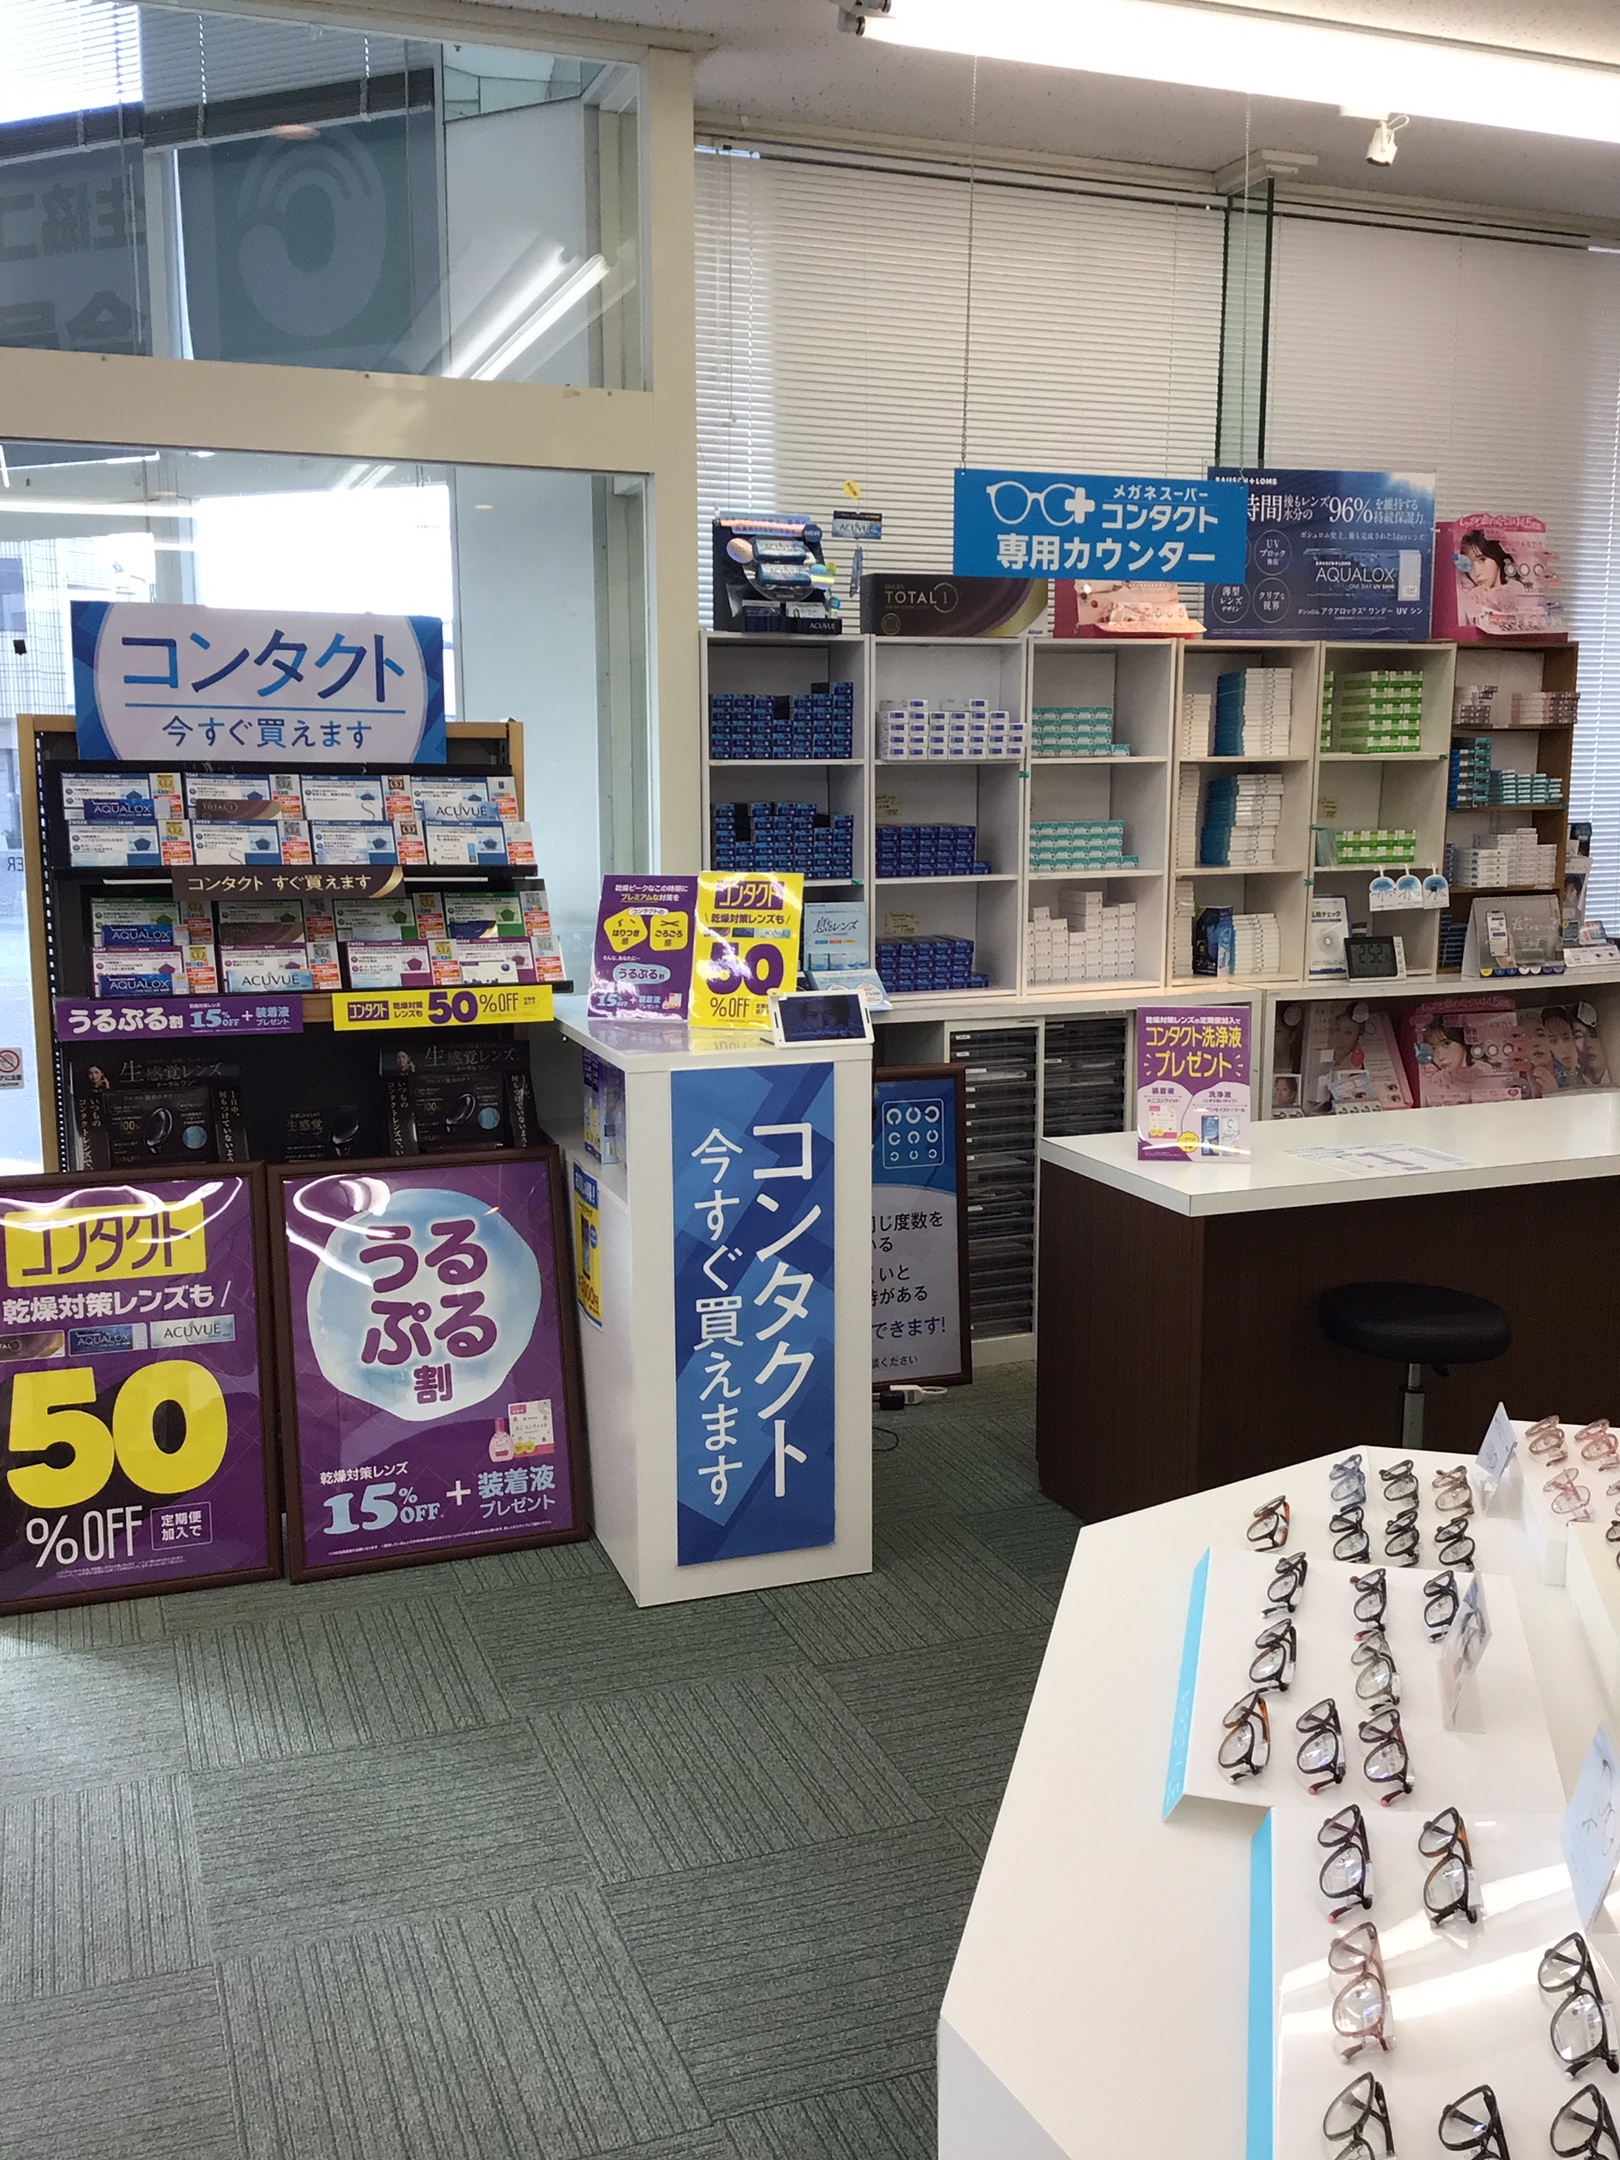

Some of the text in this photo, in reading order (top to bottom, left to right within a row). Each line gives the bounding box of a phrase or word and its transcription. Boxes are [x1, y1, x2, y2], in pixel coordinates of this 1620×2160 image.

[1113, 485, 1209, 502] メガネスーパー
[1102, 504, 1218, 533] コンタクト
[1329, 497, 1374, 524] 96%
[997, 533, 1216, 573] 専用カウンター
[1266, 539, 1280, 549] UV
[1315, 567, 1397, 584] AQUALOX
[885, 590, 937, 605] TOTAL
[1220, 596, 1242, 606] レンズ
[122, 629, 405, 702] コンタクト
[161, 715, 373, 750] 今すぐ買えます
[93, 803, 152, 815] AQUALOX
[436, 805, 488, 817] ACUVUE
[187, 873, 372, 892] コンタクト すぐ買えます
[719, 882, 784, 908] コンタクト
[711, 912, 785, 924] 乾燥対策レンズも
[112, 929, 171, 940] AQUALOX
[612, 928, 640, 938] はりつき
[654, 928, 684, 938] ごろごろ
[241, 973, 300, 986] ACUVUE
[706, 941, 784, 995] 50
[109, 979, 169, 990] AQUALOX
[348, 1003, 389, 1020] コンタクト
[394, 1010, 423, 1018] レンズも
[710, 997, 750, 1018] %OFF
[69, 1006, 184, 1034] うるぷる割
[1146, 1025, 1242, 1048] コンタクト洗浄液
[1155, 1050, 1232, 1078] プレゼント
[21, 1211, 191, 1277] コンタクト
[358, 1218, 488, 1294] うる
[3, 1284, 214, 1325] 乾燥対策レンズも
[753, 1122, 821, 1498] コンタクト
[360, 1290, 499, 1365] ぷる
[691, 1127, 744, 1506] 今すぐ買えます
[77, 1331, 131, 1348] AQUALOX
[163, 1322, 222, 1340] ACUVUE
[413, 1363, 453, 1405] 割
[6, 1359, 229, 1510] 50
[320, 1461, 408, 1486] 乾燥対策レンズ
[477, 1464, 556, 1500] 装着液
[160, 1509, 203, 1527] 定期便
[479, 1495, 556, 1519] プレゼント
[26, 1504, 143, 1569] %OFF
[161, 1523, 202, 1541] 加入で
